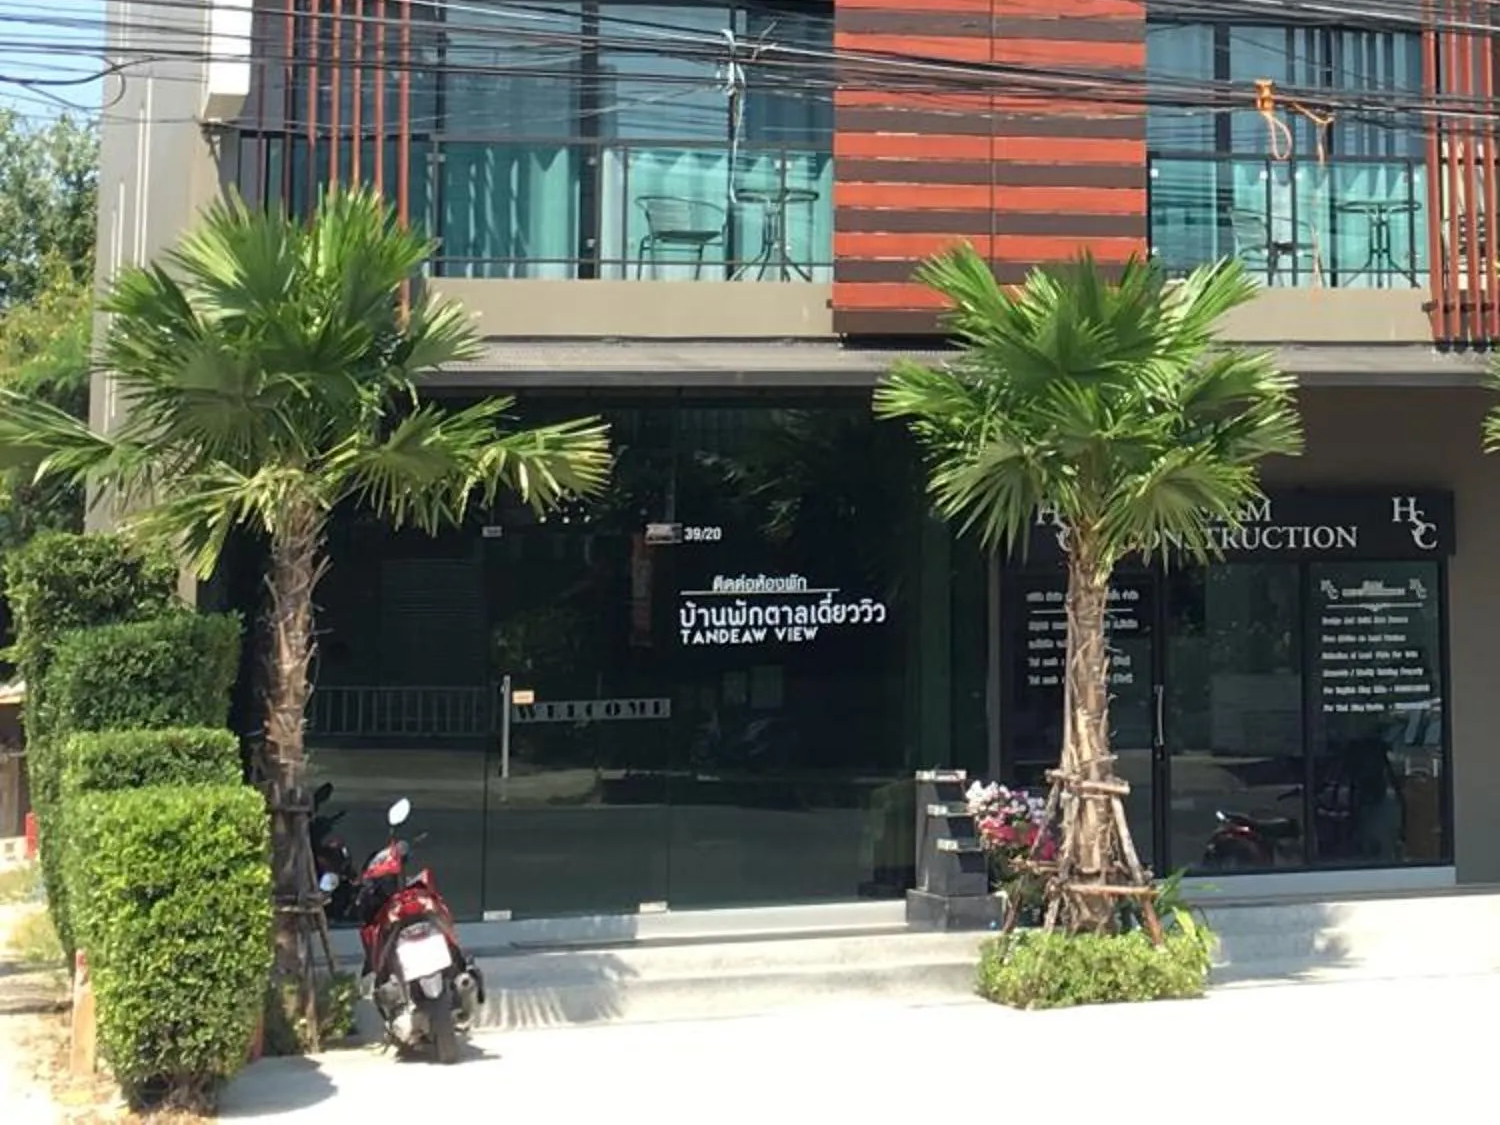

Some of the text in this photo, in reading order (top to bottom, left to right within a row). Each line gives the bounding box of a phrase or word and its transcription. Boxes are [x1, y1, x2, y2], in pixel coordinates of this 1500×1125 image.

[684, 527, 722, 541] 39/20
[680, 592, 886, 628] บ้านพักตาลเดี่ยววิว
[681, 626, 819, 645] TANDEAW VIEW
